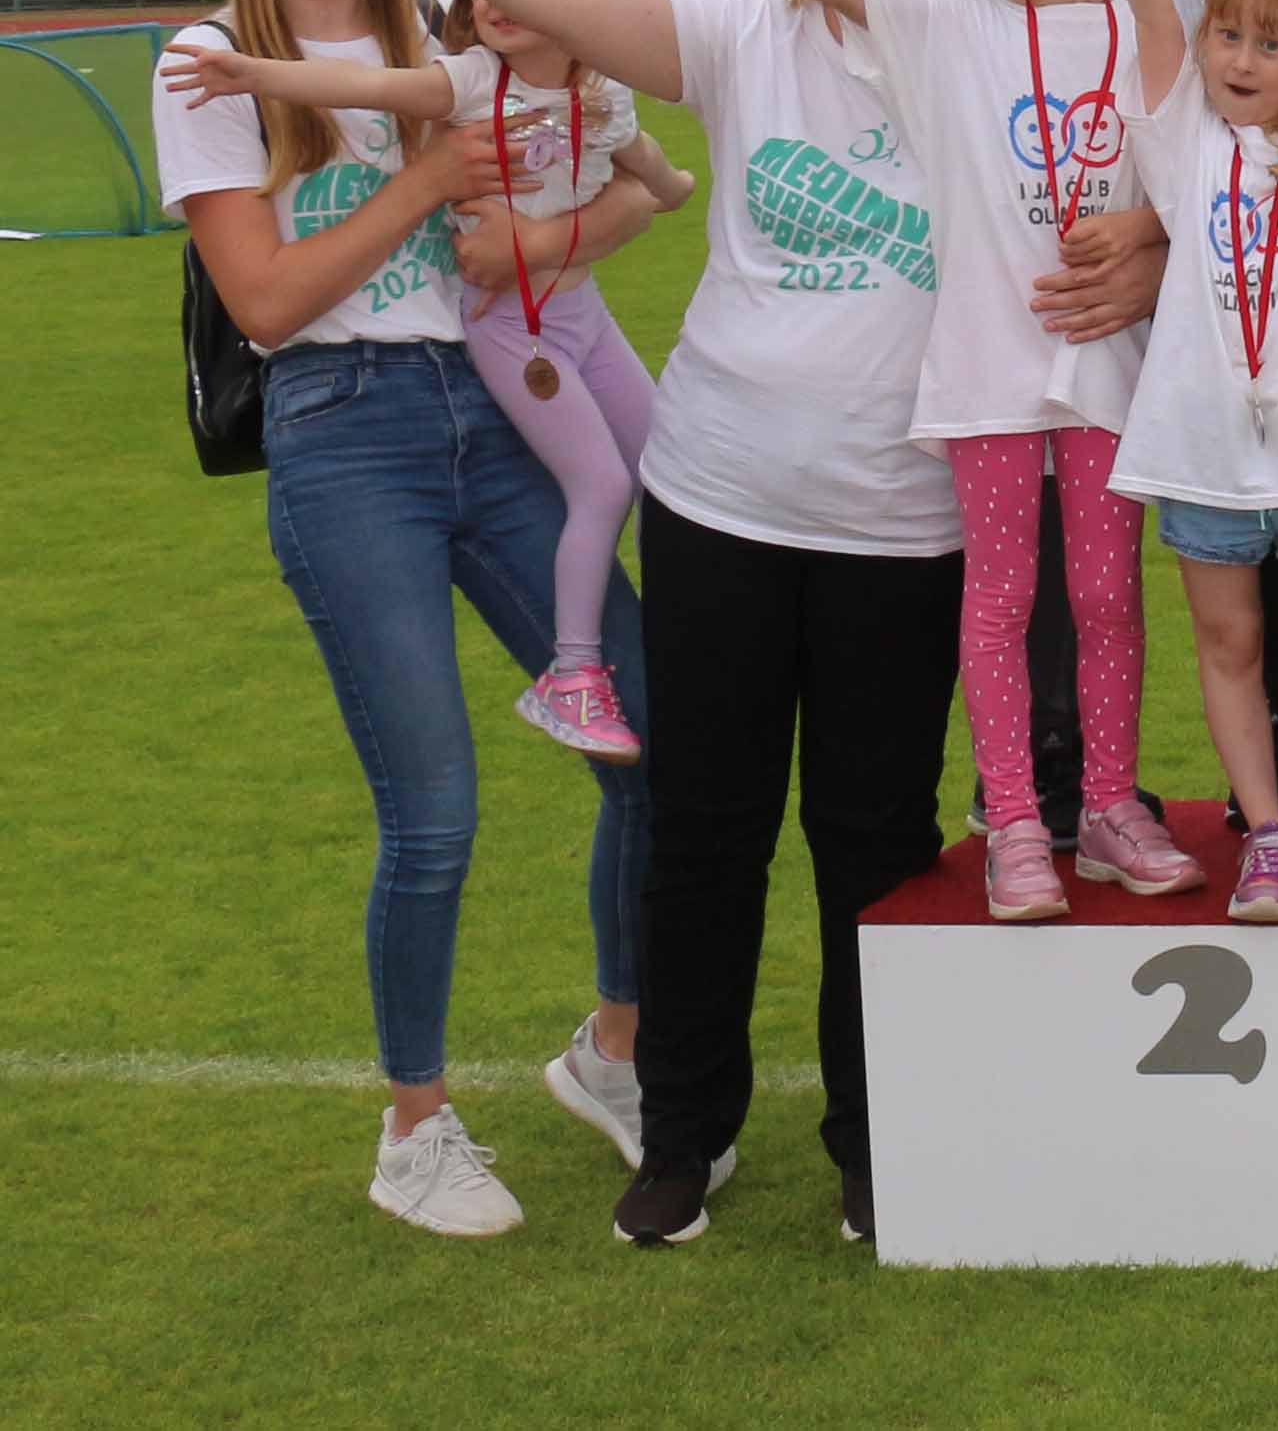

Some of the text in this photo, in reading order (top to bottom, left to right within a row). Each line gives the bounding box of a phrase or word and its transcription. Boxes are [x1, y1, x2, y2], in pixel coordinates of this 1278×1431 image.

[362, 259, 429, 314] 202
[778, 261, 880, 291] 2022.
[1131, 944, 1267, 1085] 2
